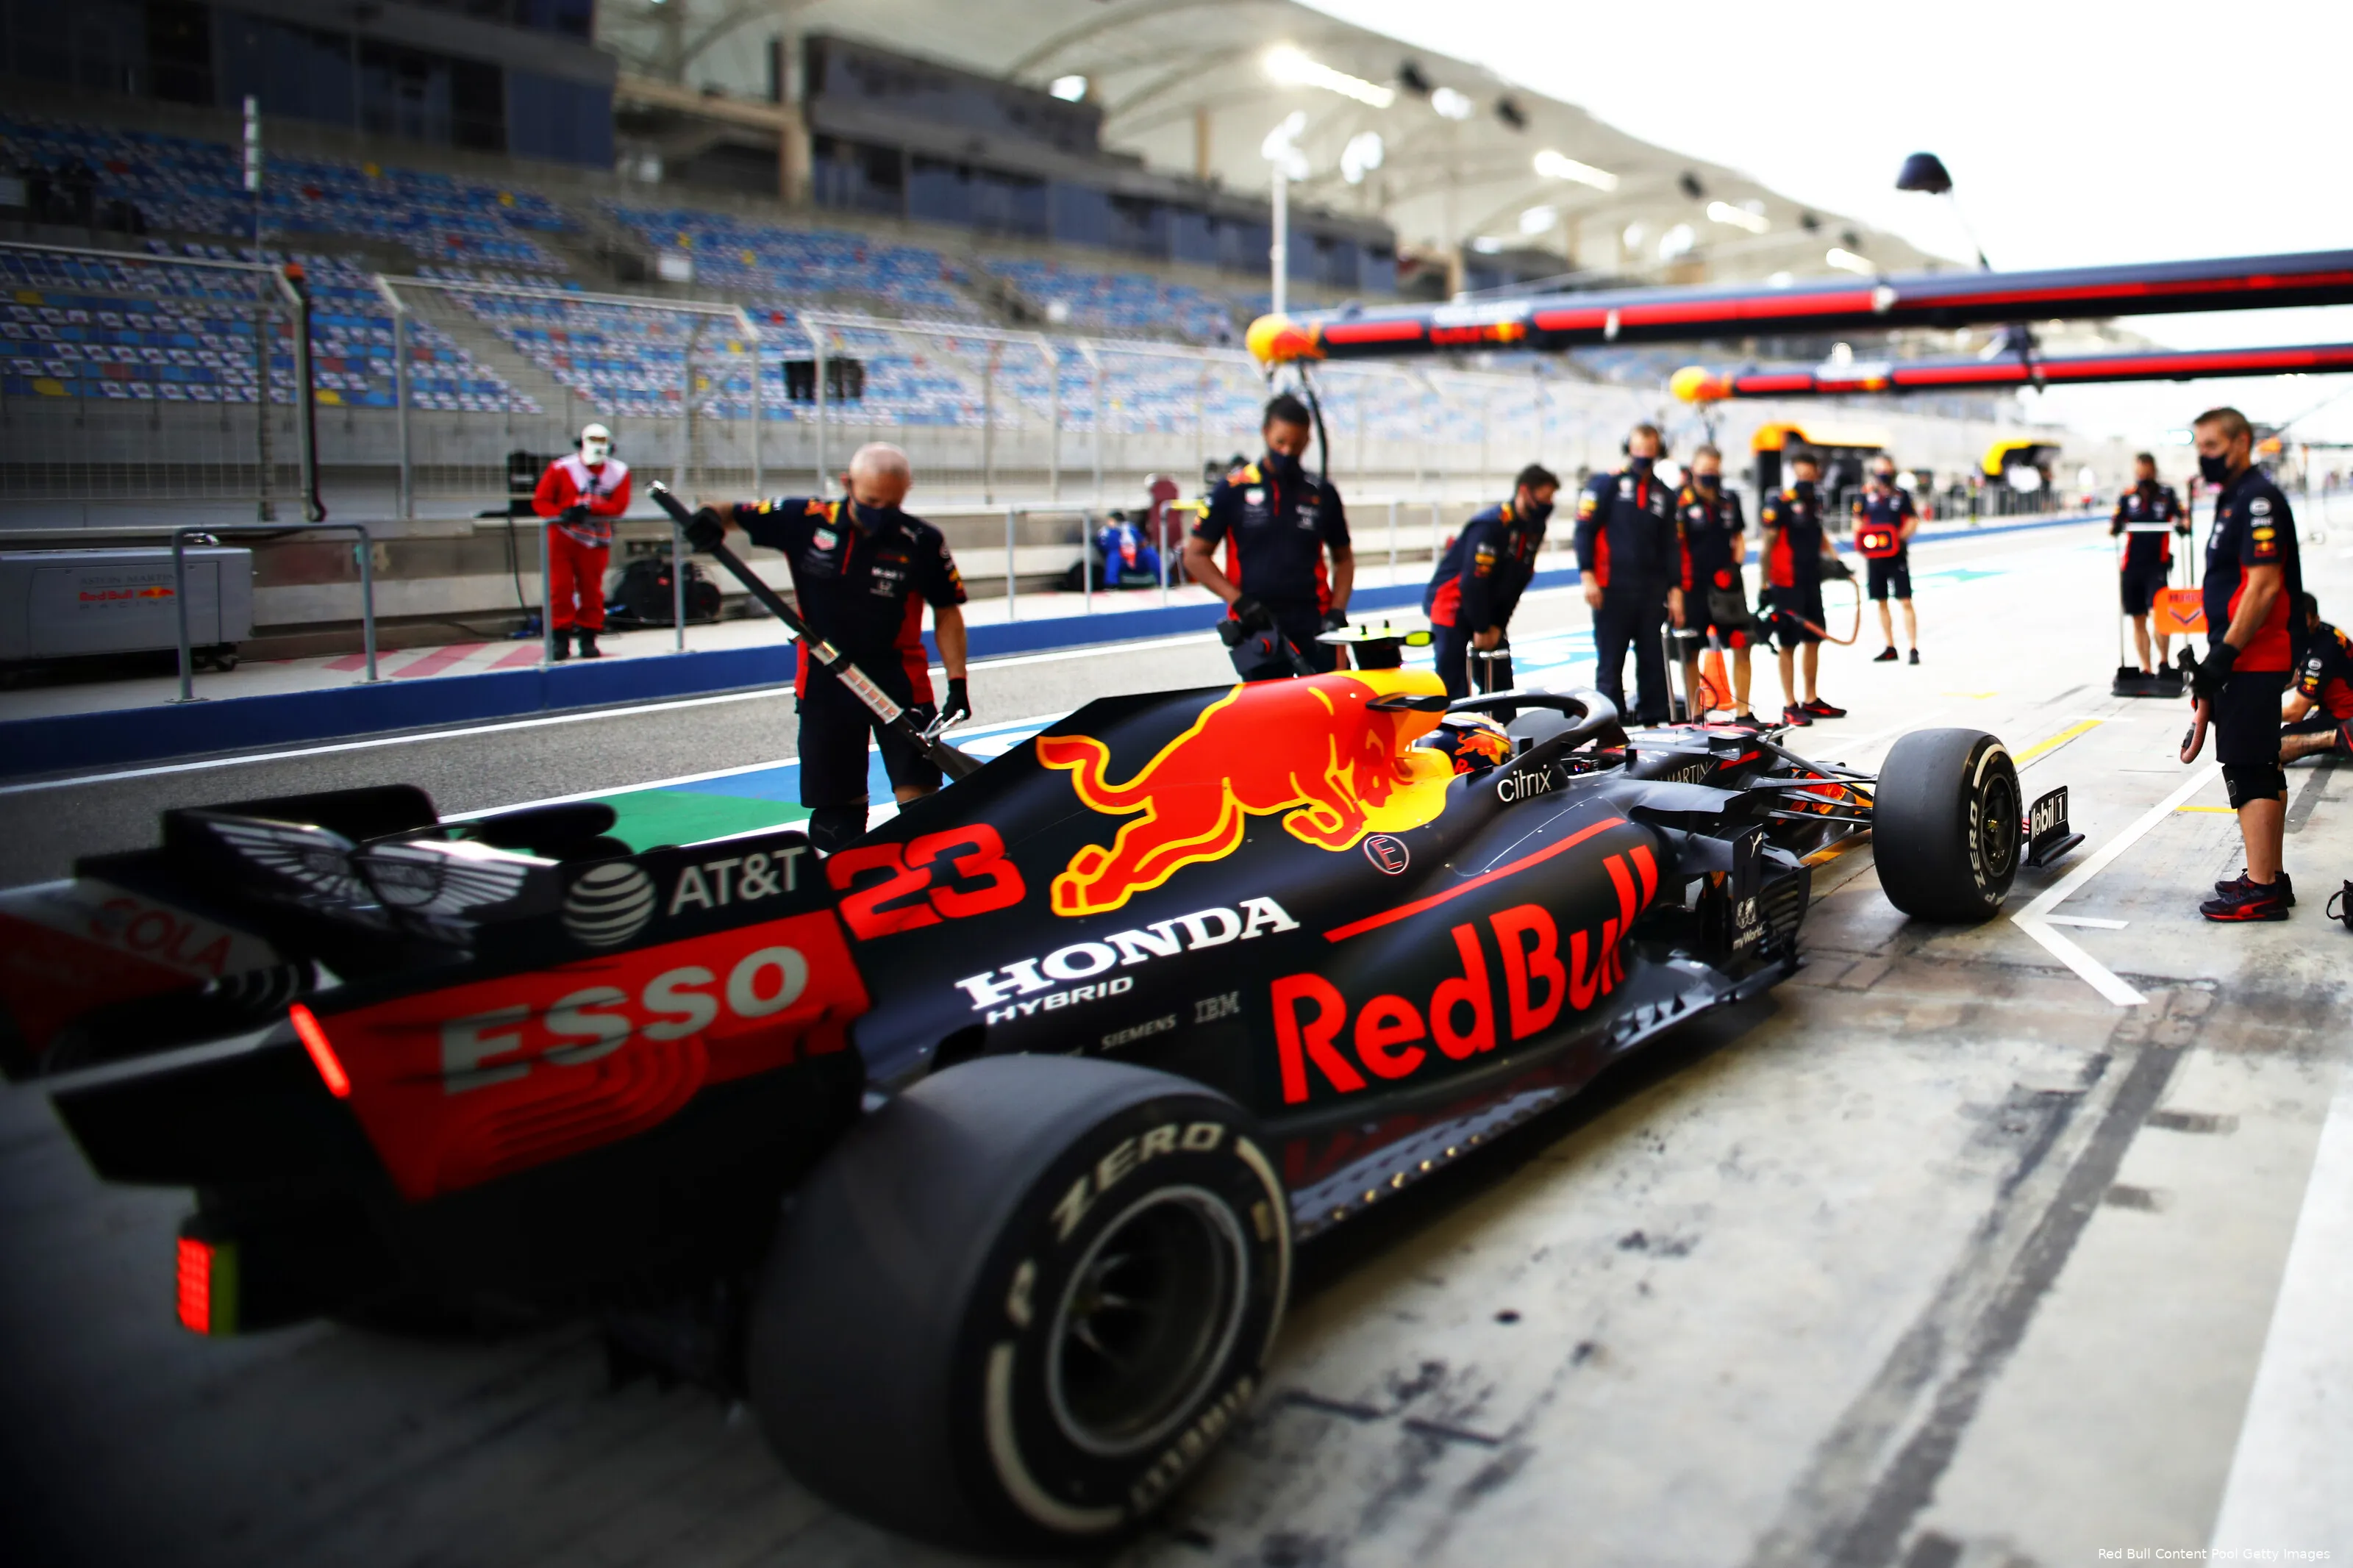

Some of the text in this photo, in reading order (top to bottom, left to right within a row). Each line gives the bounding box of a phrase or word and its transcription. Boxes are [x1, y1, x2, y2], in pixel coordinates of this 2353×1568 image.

[1497, 765, 1552, 803] citrix
[1970, 799, 1986, 889] ZERO
[668, 845, 807, 916] AT&T
[826, 823, 1026, 941] 23
[954, 895, 1301, 1011] HONDA
[1733, 925, 1764, 951] myWorld
[441, 945, 807, 1095] ESSO
[985, 975, 1135, 1025] HYBRID
[1100, 1013, 1176, 1051] SIEMENS
[1194, 991, 1241, 1024] IBM
[1051, 1123, 1225, 1244] ZERO
